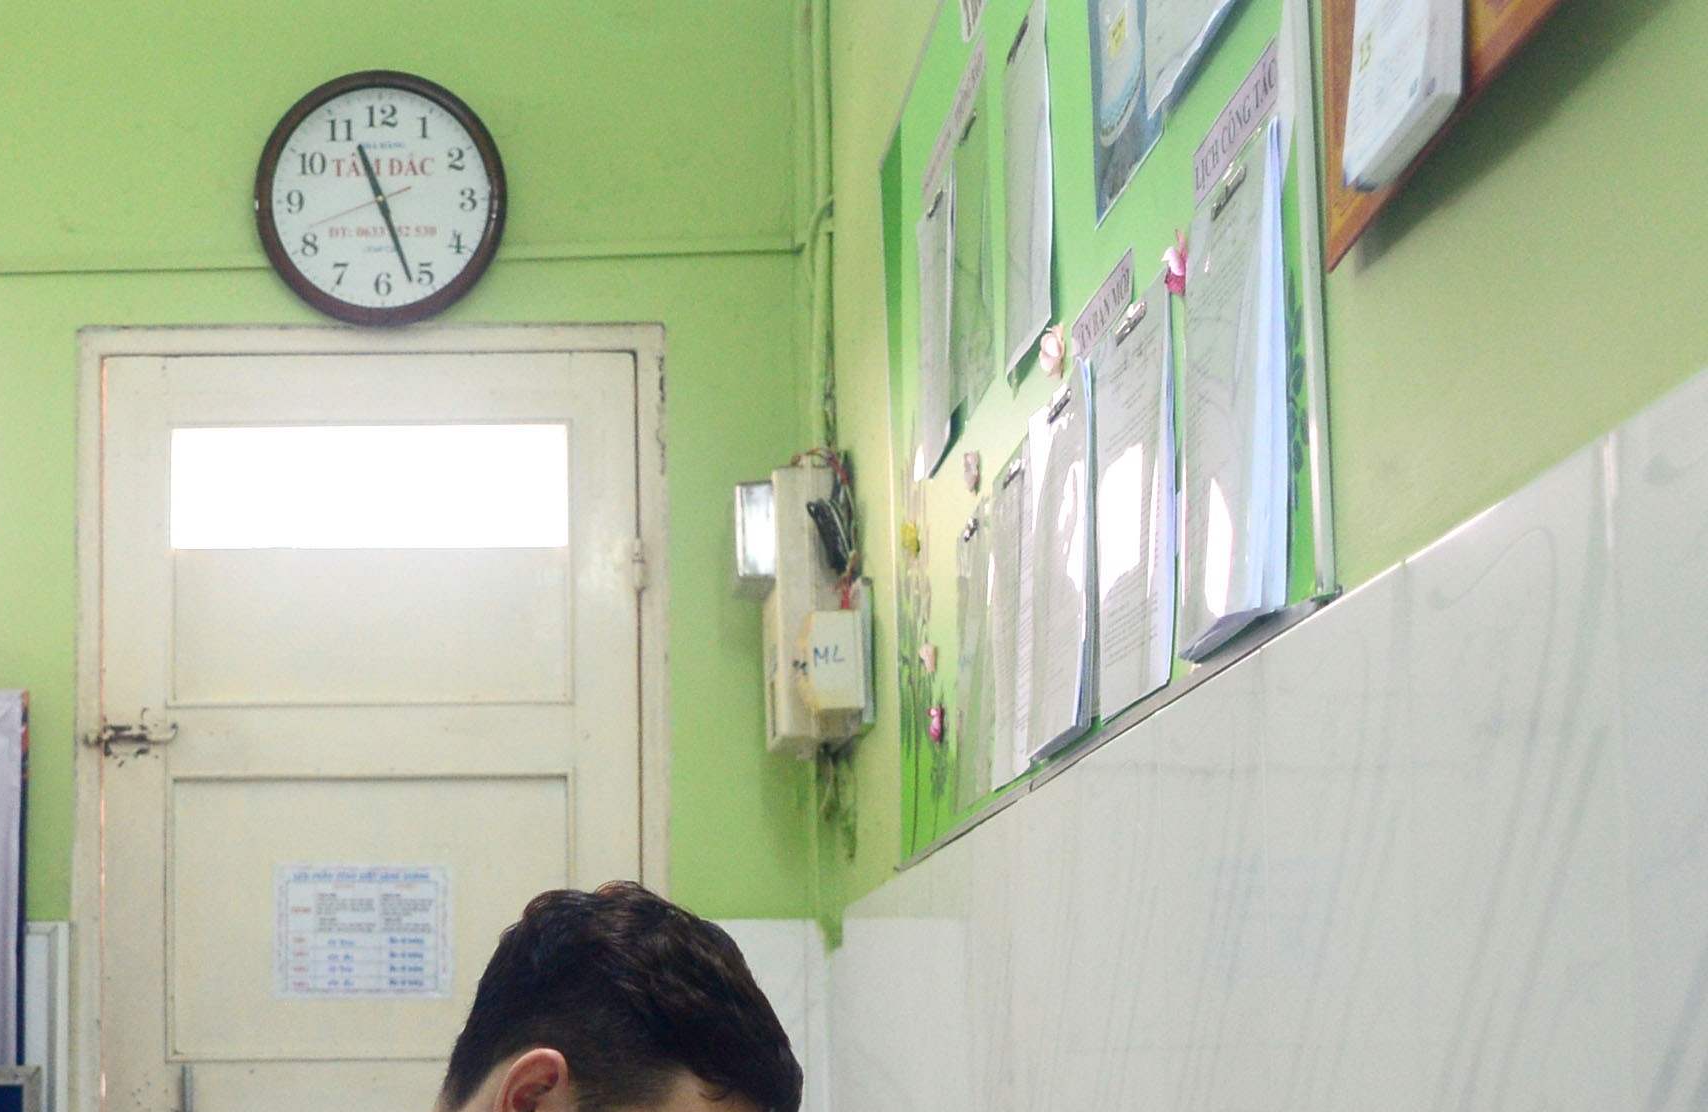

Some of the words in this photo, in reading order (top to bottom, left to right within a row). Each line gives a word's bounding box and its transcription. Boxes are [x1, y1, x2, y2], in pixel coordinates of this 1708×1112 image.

[366, 104, 398, 128] 12
[418, 115, 429, 140] 1
[328, 118, 353, 142] 11
[298, 152, 326, 176] 10
[447, 148, 466, 172] 2
[286, 189, 305, 214] 9
[459, 187, 478, 212] 3
[301, 232, 319, 257] 8
[448, 229, 467, 254] 4
[332, 262, 349, 286] 7
[374, 272, 392, 296] 6
[417, 262, 434, 286] 5
